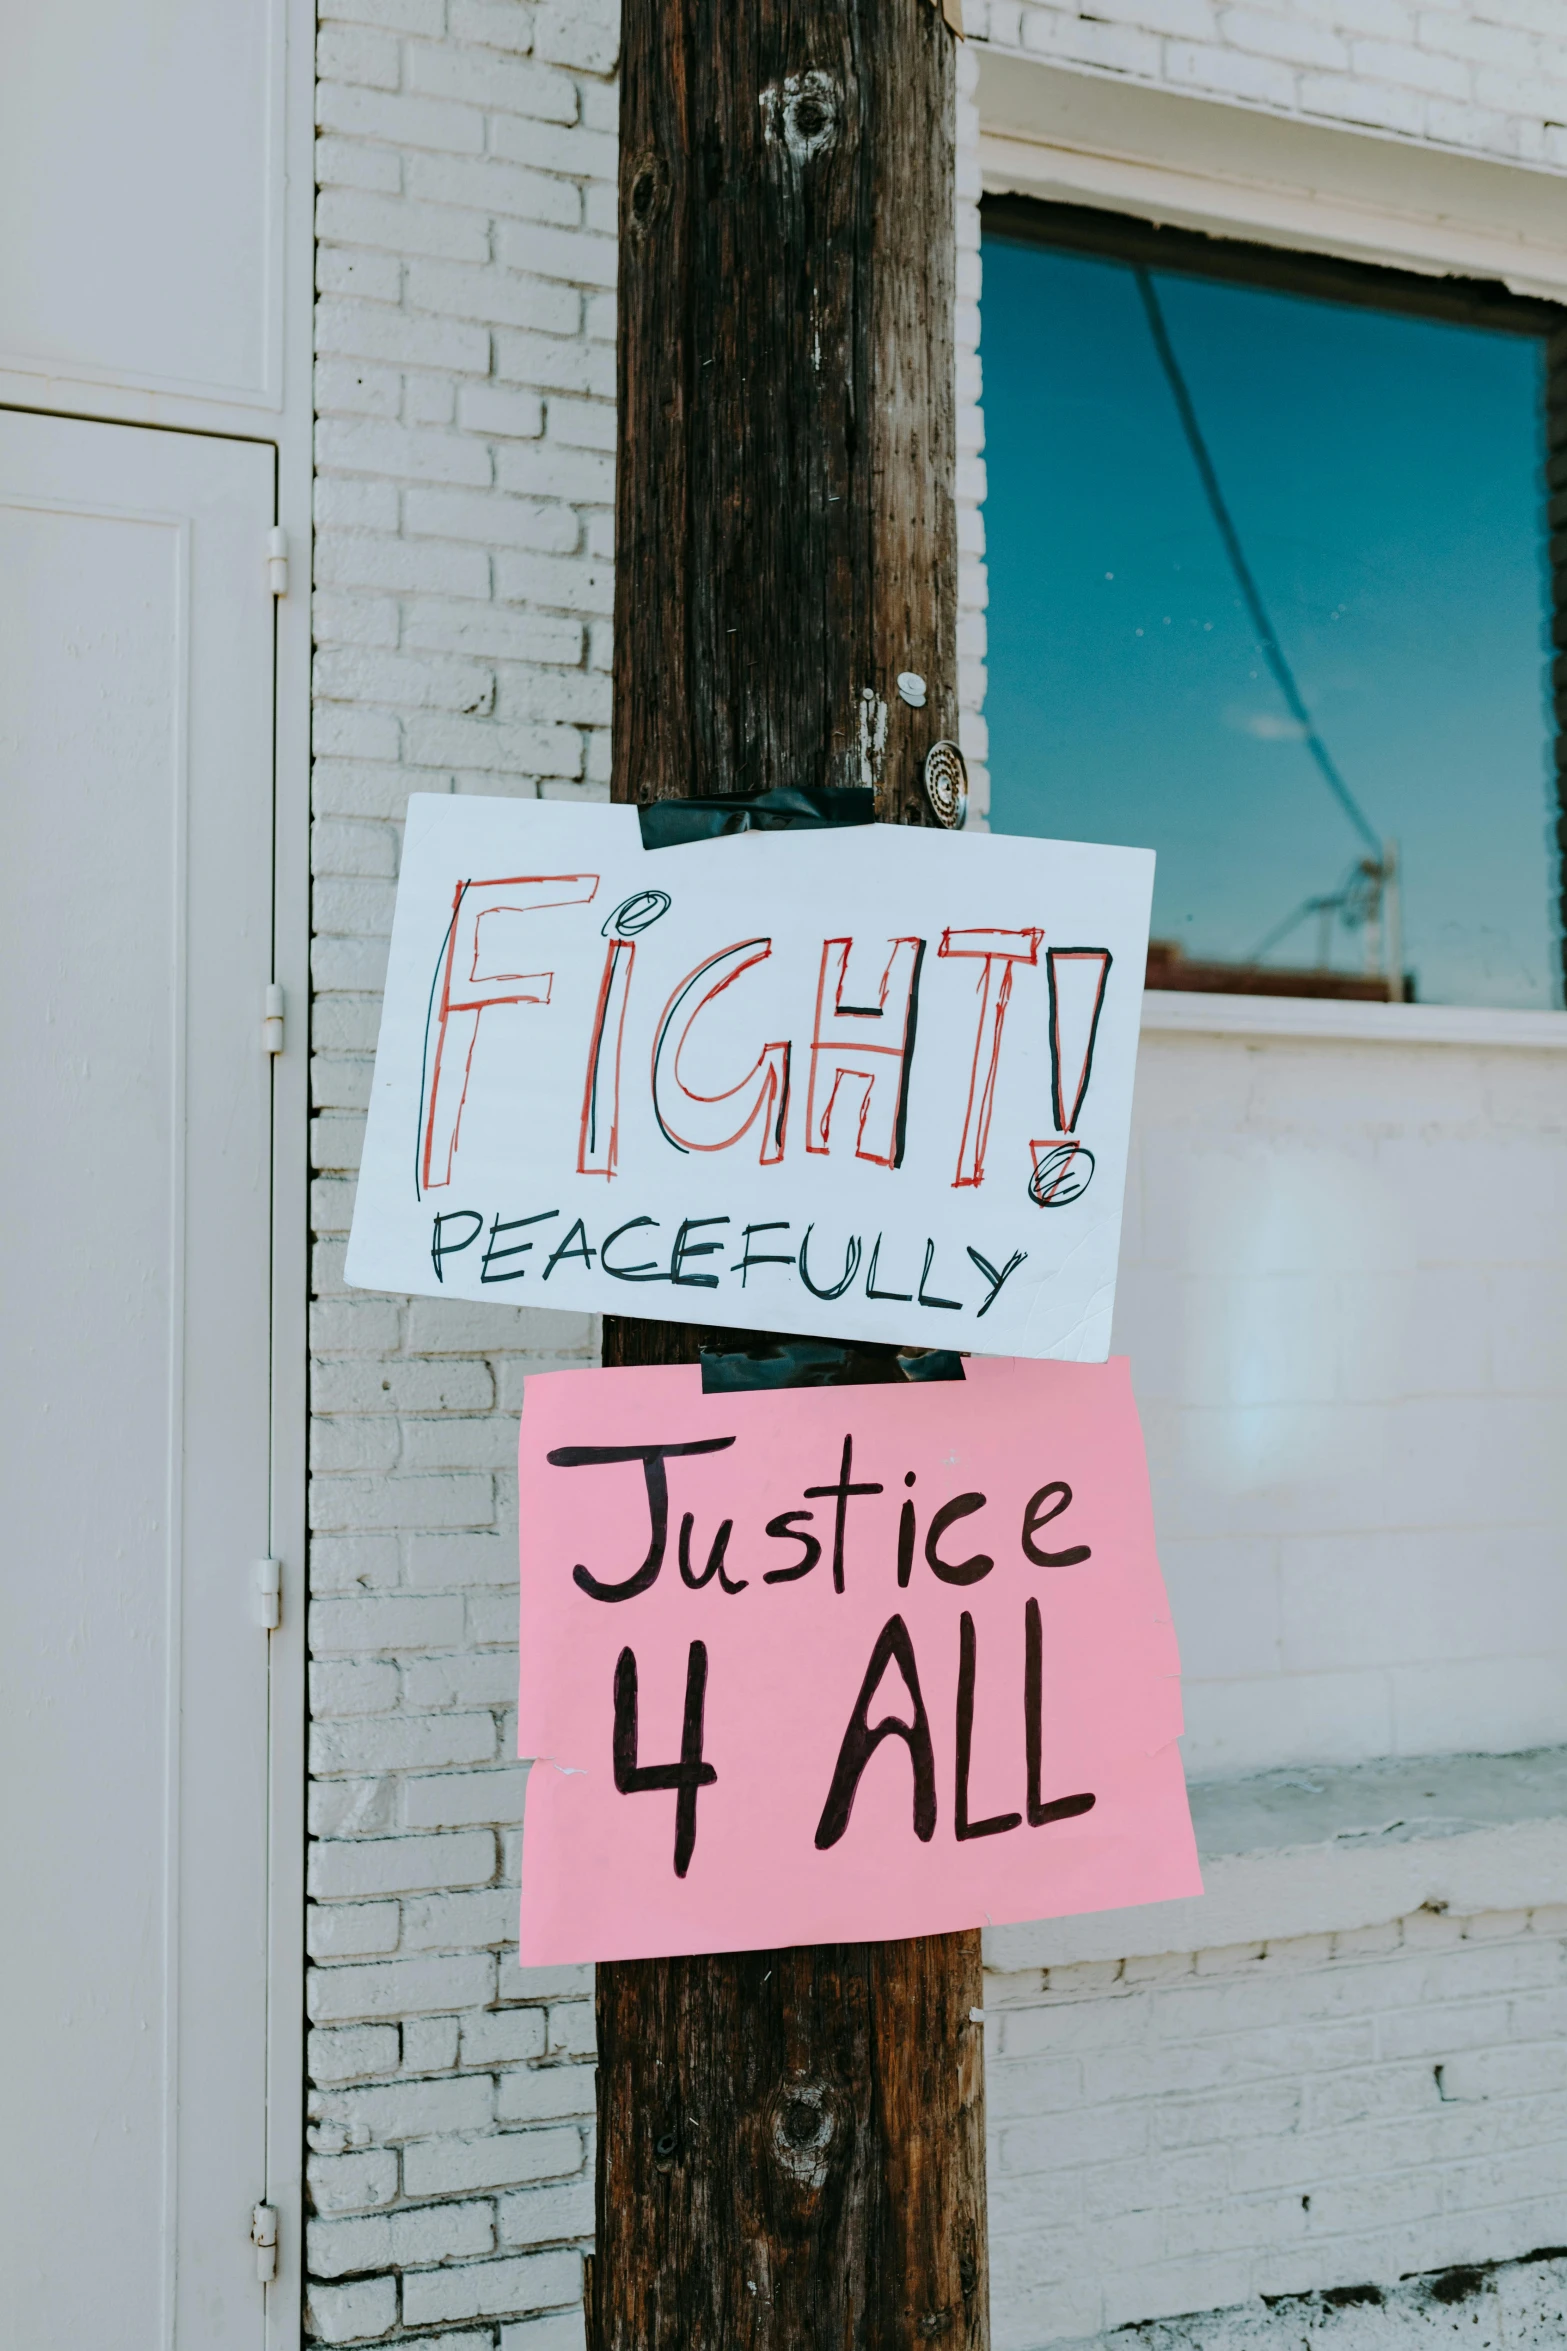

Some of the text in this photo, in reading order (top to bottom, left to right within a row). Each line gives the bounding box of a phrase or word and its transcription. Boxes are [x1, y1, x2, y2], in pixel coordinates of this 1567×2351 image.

[431, 1209, 1029, 1319] PEACEFULLY
[547, 1433, 1092, 1603] Justice
[613, 1597, 1097, 1879] 4 ALL
